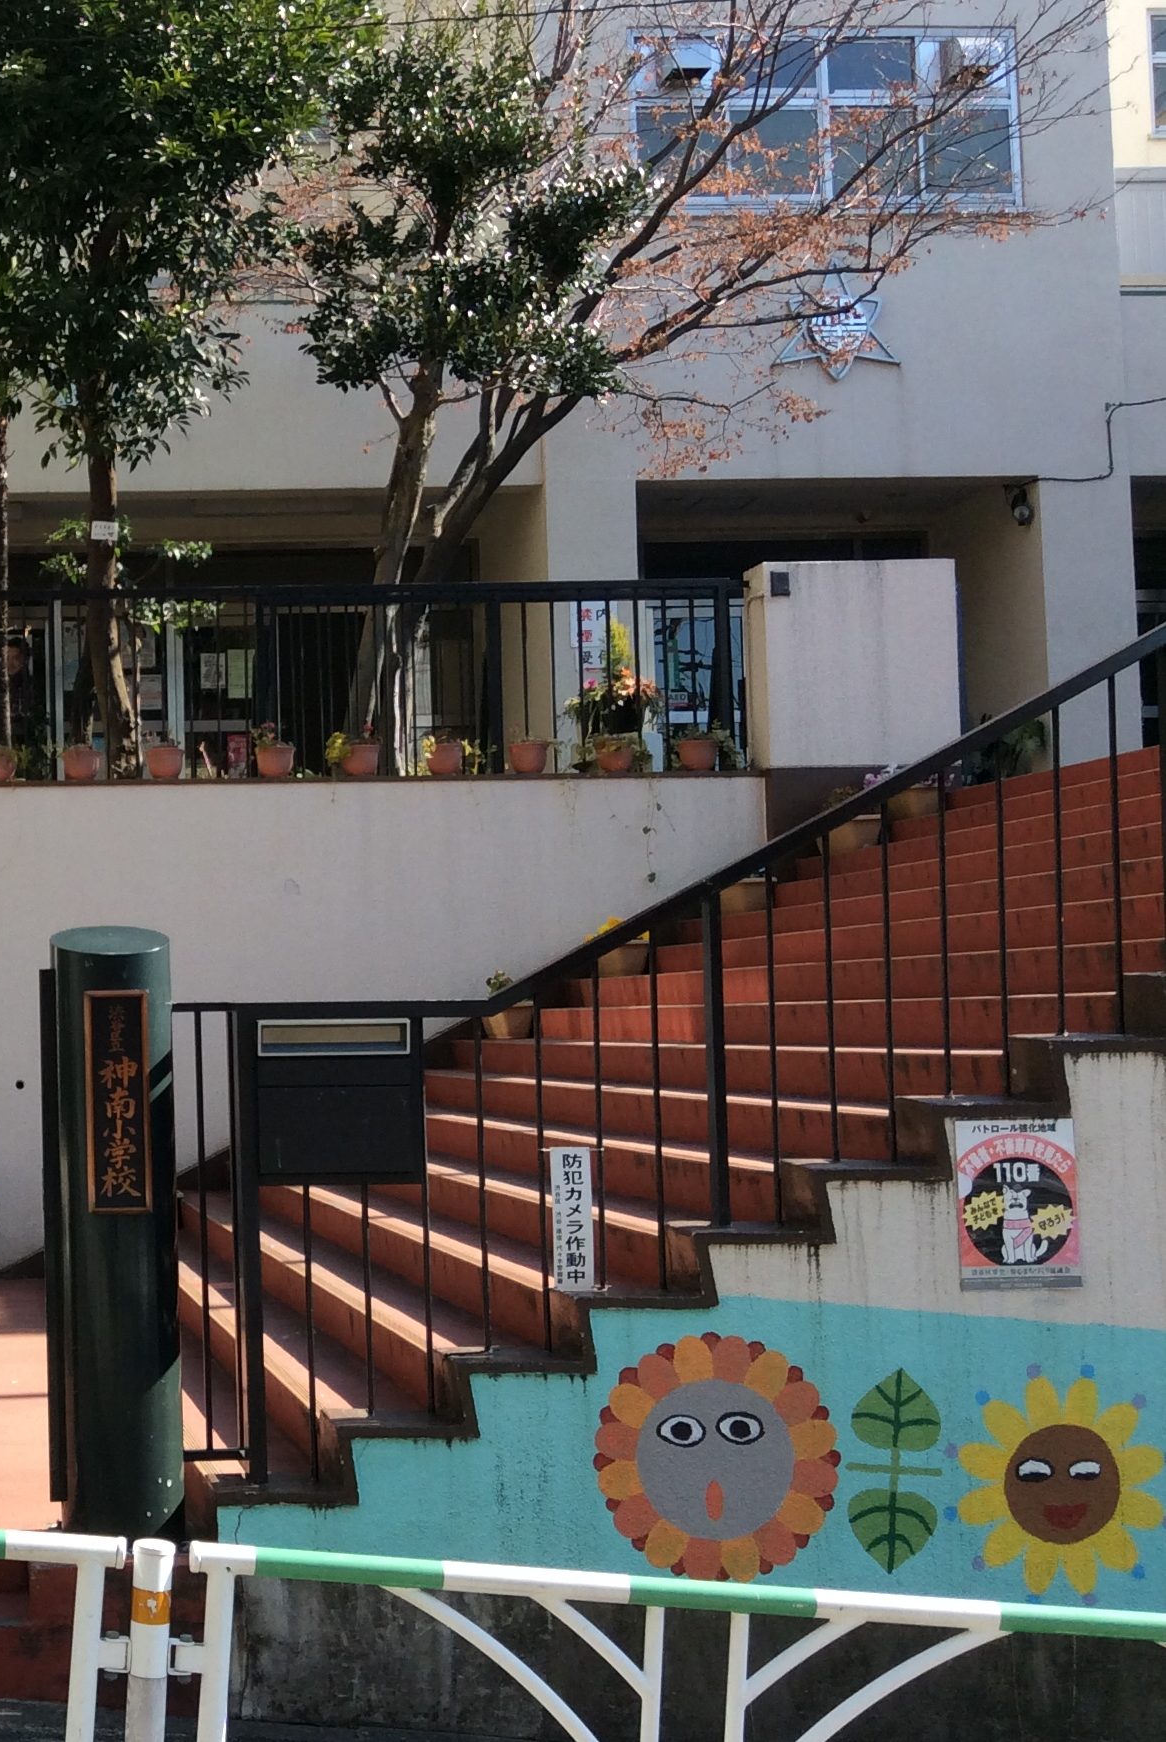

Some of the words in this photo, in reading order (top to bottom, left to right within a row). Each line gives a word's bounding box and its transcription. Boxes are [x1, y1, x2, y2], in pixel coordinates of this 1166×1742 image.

[98, 1056, 142, 1198] 神南小学校
[993, 1162, 1041, 1183] 110番
[969, 1197, 998, 1215] みんなで
[972, 1208, 999, 1224] 子どもを
[562, 1153, 586, 1285] 防犯カメラ作動中
